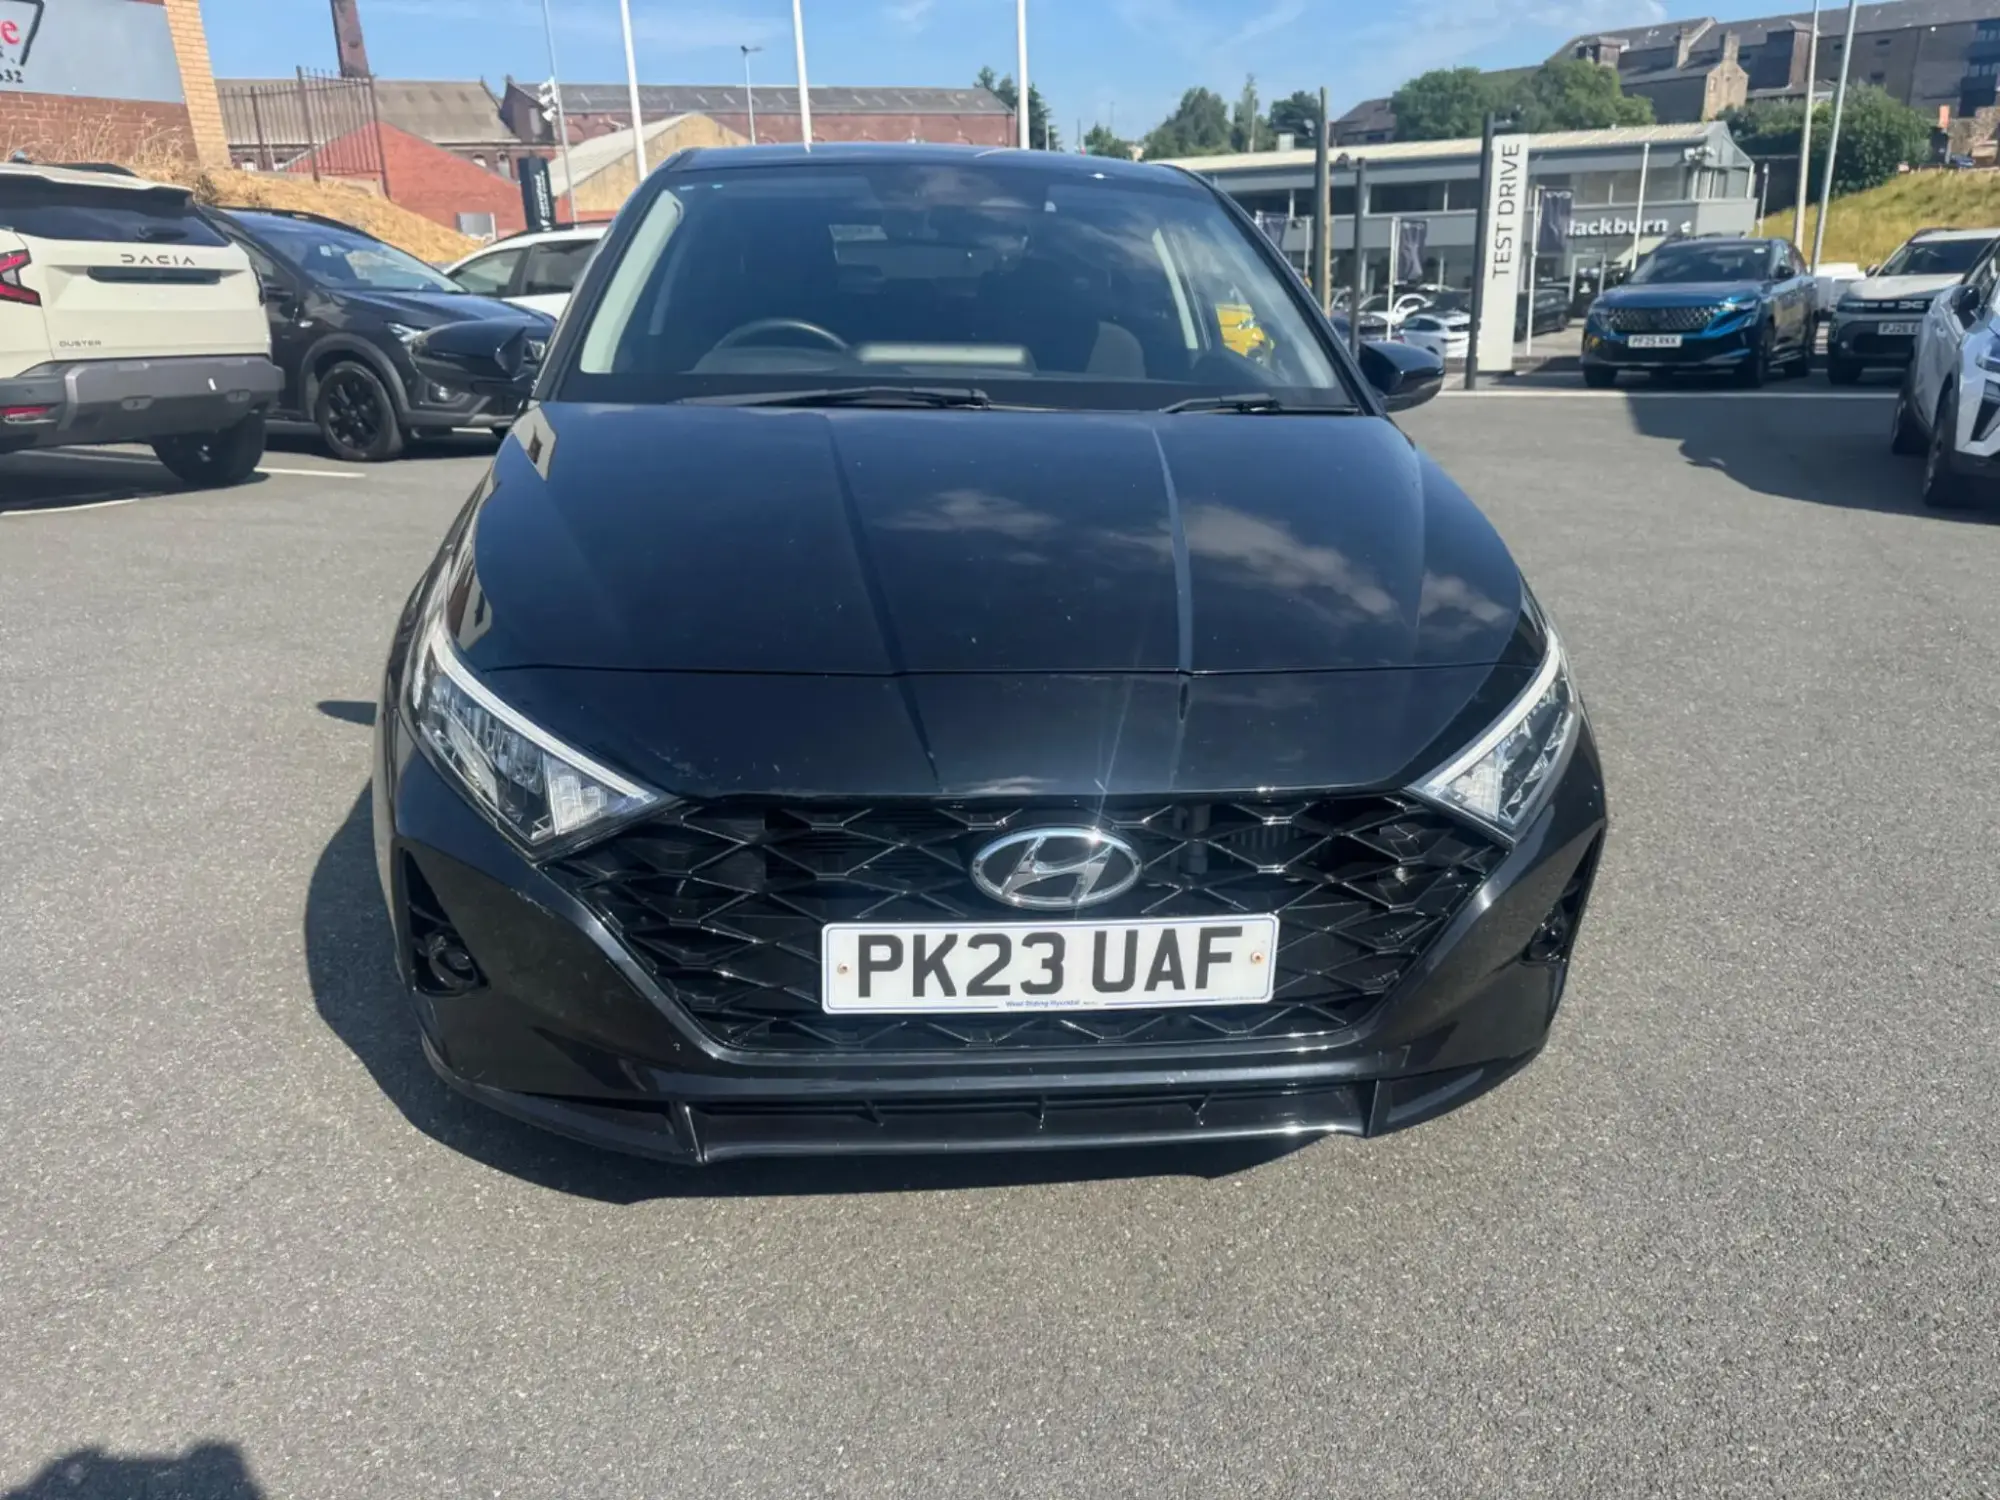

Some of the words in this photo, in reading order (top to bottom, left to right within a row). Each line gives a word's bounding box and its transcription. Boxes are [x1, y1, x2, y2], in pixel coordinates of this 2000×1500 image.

[1497, 143, 1520, 216] DRIVE
[1565, 217, 1669, 237] lackburn
[120, 253, 196, 266] DACIA
[1492, 222, 1515, 280] TEST
[58, 339, 103, 348] DUSTER
[857, 931, 1067, 998] PK23
[1091, 925, 1243, 994] UAF
